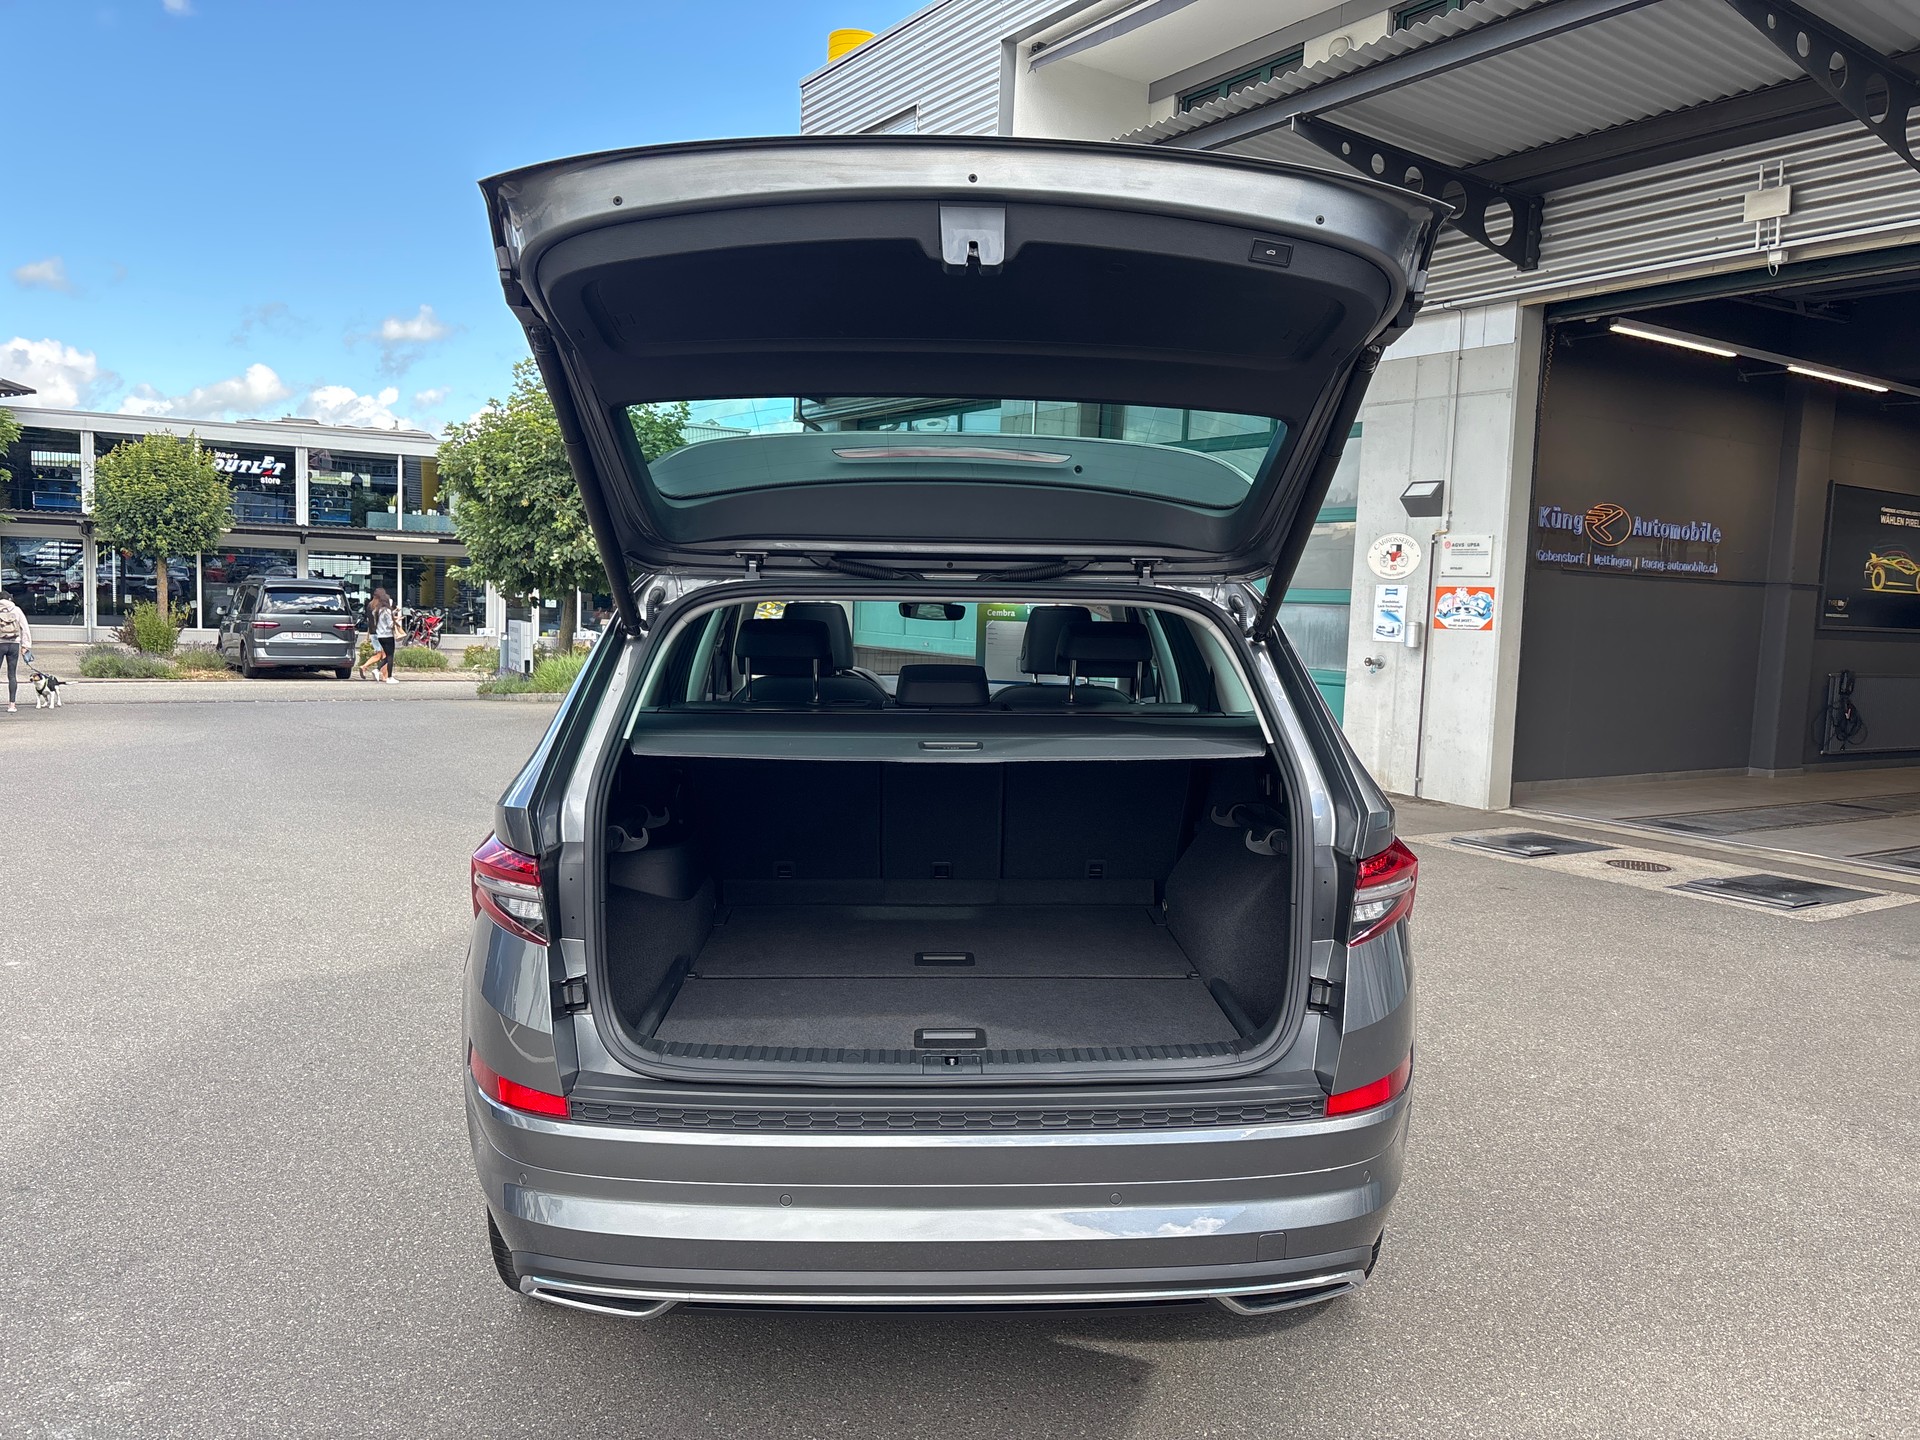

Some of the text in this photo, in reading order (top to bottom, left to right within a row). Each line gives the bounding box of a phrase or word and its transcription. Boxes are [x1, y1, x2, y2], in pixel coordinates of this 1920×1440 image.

[212, 456, 286, 475] OUTLET
[260, 477, 281, 485] store
[1538, 506, 1722, 543] Küng Automobile
[1880, 514, 1904, 526] WÄHLEN
[1374, 536, 1416, 550] CARROSSERIE
[1537, 550, 1718, 574] Gebenstorf Wettingen kueng-automobile.ch
[987, 609, 1016, 617] Cembra
